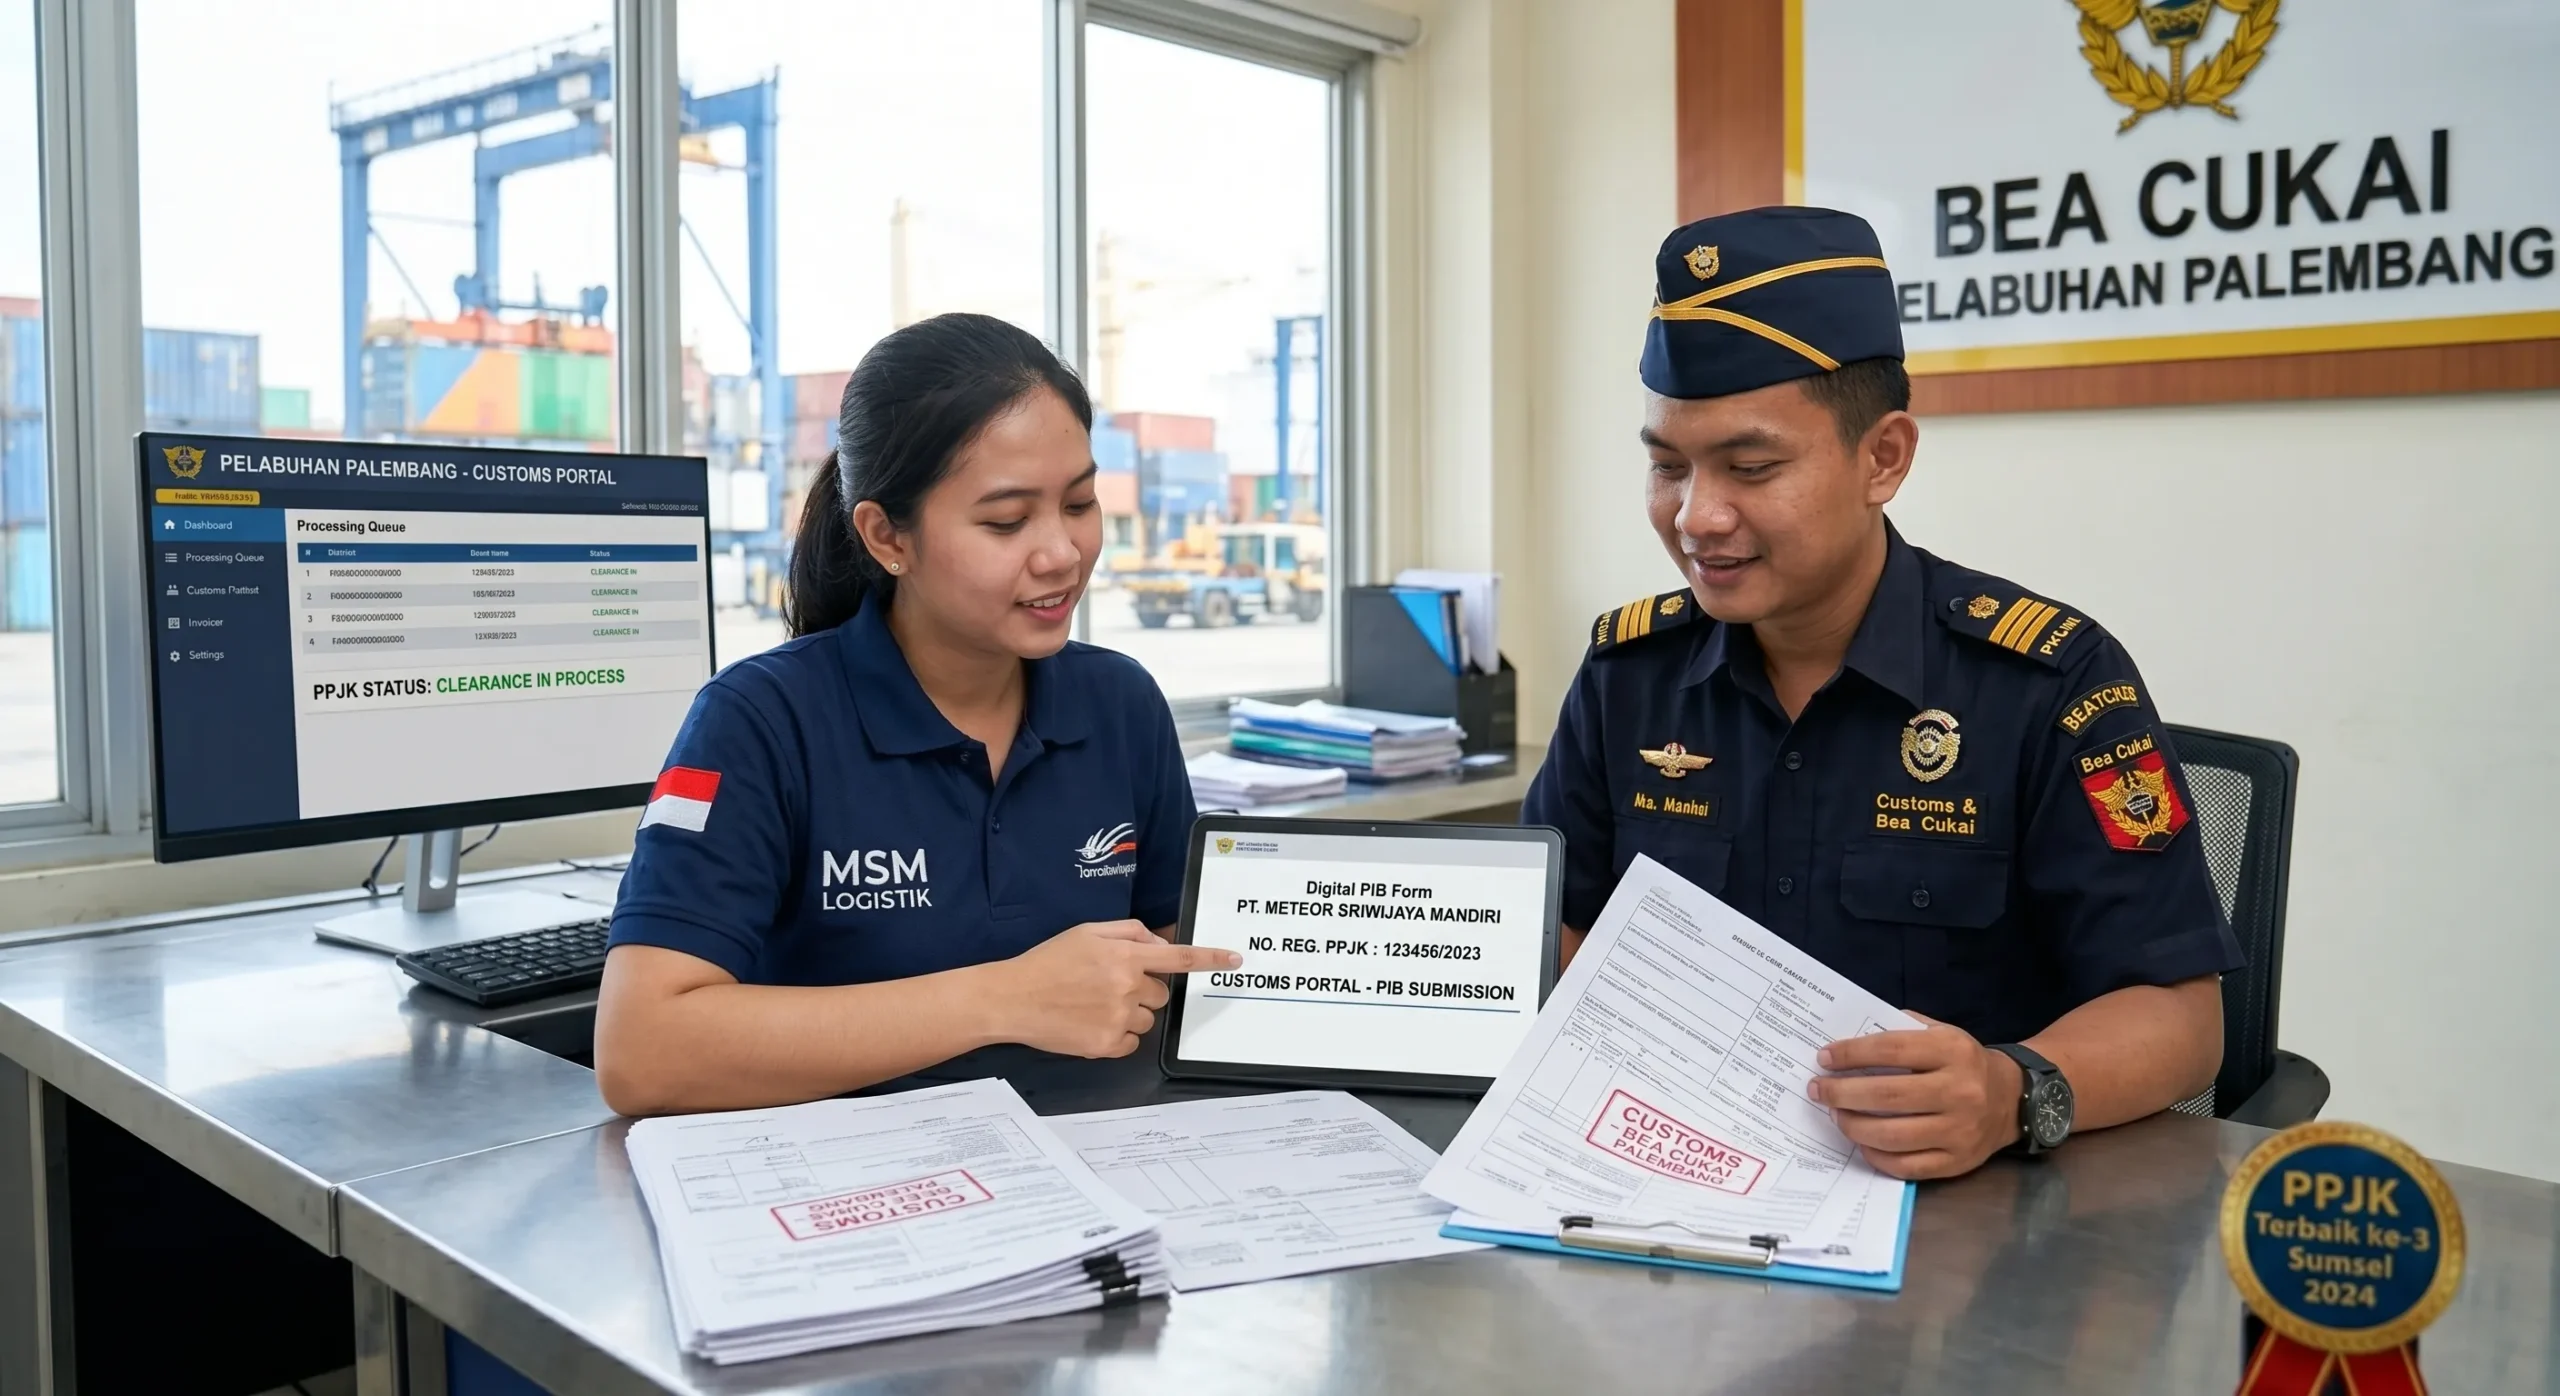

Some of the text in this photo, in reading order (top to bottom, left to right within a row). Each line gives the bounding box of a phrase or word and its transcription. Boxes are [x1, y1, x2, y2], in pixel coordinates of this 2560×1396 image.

[1935, 129, 2448, 258] BEA CUKAI
[1898, 227, 2554, 323] ELABUHAN PALEMBANG
[220, 454, 340, 475] PELABUHAN
[346, 459, 457, 480] PALEMBANG
[472, 464, 552, 483] CUSTOMS
[557, 468, 617, 485] PORTAL
[184, 520, 232, 530] Dashboard
[297, 519, 406, 535] Processing Queue
[185, 552, 264, 564] Processing Queue
[306, 569, 310, 577] 1
[187, 586, 226, 595] Customs
[307, 615, 313, 623] 3
[189, 650, 224, 661] Settings
[309, 638, 314, 646] 4
[313, 668, 625, 700] PPJK STATUS: CLEARANCE IN PROCESS
[2080, 733, 2153, 773] Bea Cukai
[1877, 793, 1977, 814] Customs &
[1876, 814, 1975, 834] Bea Cukai
[823, 848, 928, 887] MSM
[823, 888, 932, 910] LOGISTIK
[1306, 880, 1432, 899] Digital PIB Form
[1237, 899, 1501, 924] PT. METEOR SRIWIJAYA MANDIRI
[1249, 936, 1481, 960] NO. REG. PPJK : 123456/2023
[1211, 972, 1291, 990] CUSTOMS
[1296, 976, 1361, 993] PORTAL
[1376, 980, 1404, 995] PIB
[1408, 981, 1515, 1001] SUBMISSION
[1622, 1106, 1743, 1169] CUSTOMS
[1613, 1138, 1724, 1185] PALEMBANG
[1622, 1126, 1662, 1154] BEA
[1670, 1150, 1733, 1178] CUKAI
[2283, 1169, 2400, 1217] PPJK
[814, 1194, 966, 1231] CUSTOMS
[2254, 1211, 2430, 1252] Terbaik ke-3
[2287, 1246, 2393, 1280] Sumsel
[2304, 1279, 2376, 1307] 2024
